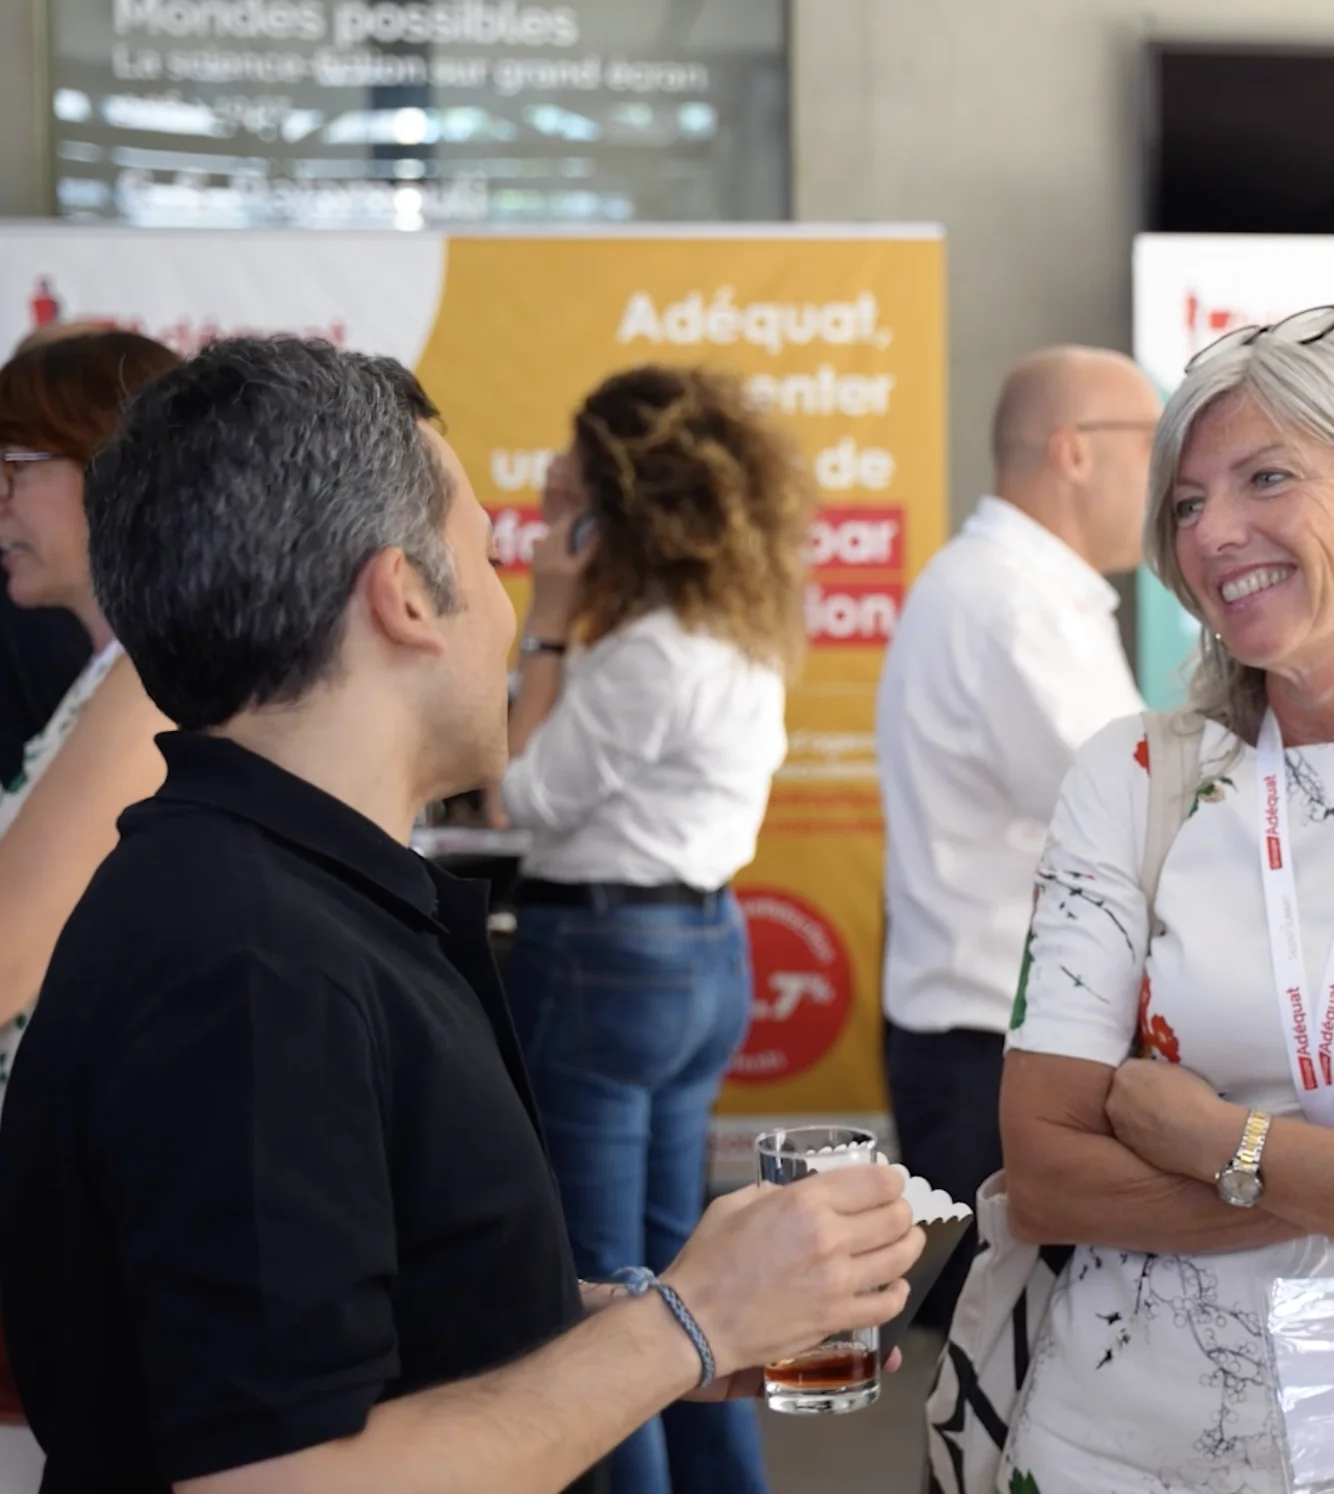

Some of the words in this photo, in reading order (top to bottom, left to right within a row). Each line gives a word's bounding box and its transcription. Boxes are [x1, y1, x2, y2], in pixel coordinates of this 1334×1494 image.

[111, 0, 325, 39] Mondes
[334, 0, 579, 49] possibles
[112, 41, 162, 80] La
[430, 55, 487, 88] sur
[493, 51, 600, 96] grand
[604, 52, 709, 93] écran
[616, 284, 893, 355] Adéquat,
[743, 363, 895, 416] enter
[813, 438, 896, 491] de
[1286, 985, 1311, 1057] Adéquat
